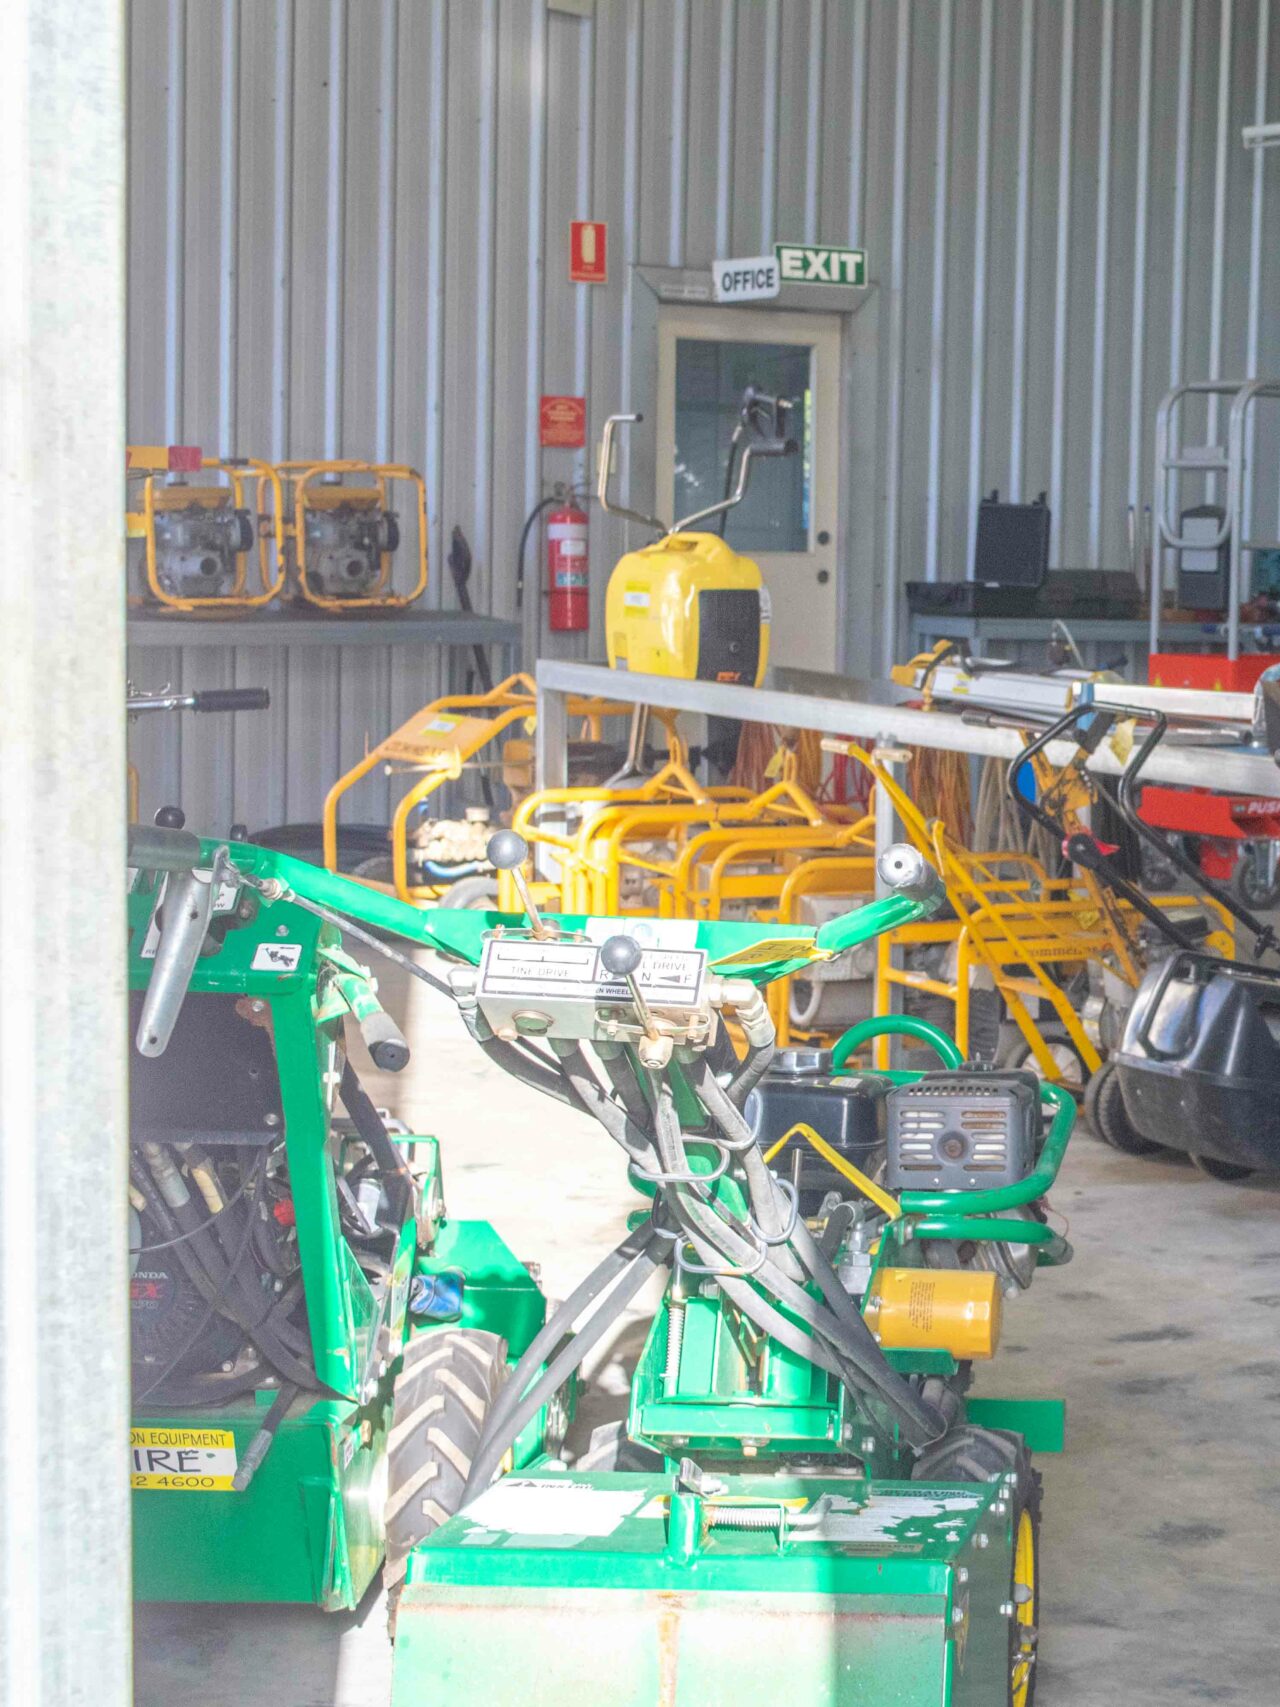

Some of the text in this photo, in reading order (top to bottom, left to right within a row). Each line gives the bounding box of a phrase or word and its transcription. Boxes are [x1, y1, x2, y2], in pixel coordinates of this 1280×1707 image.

[780, 249, 862, 283] EXIT
[721, 268, 775, 292] OFFICE
[538, 967, 569, 977] DRIVE
[652, 961, 686, 971] DRIVE
[600, 970, 608, 980] R
[642, 972, 651, 981] N
[150, 1432, 226, 1447] EQUIPMENT
[157, 1476, 216, 1488] 4600
